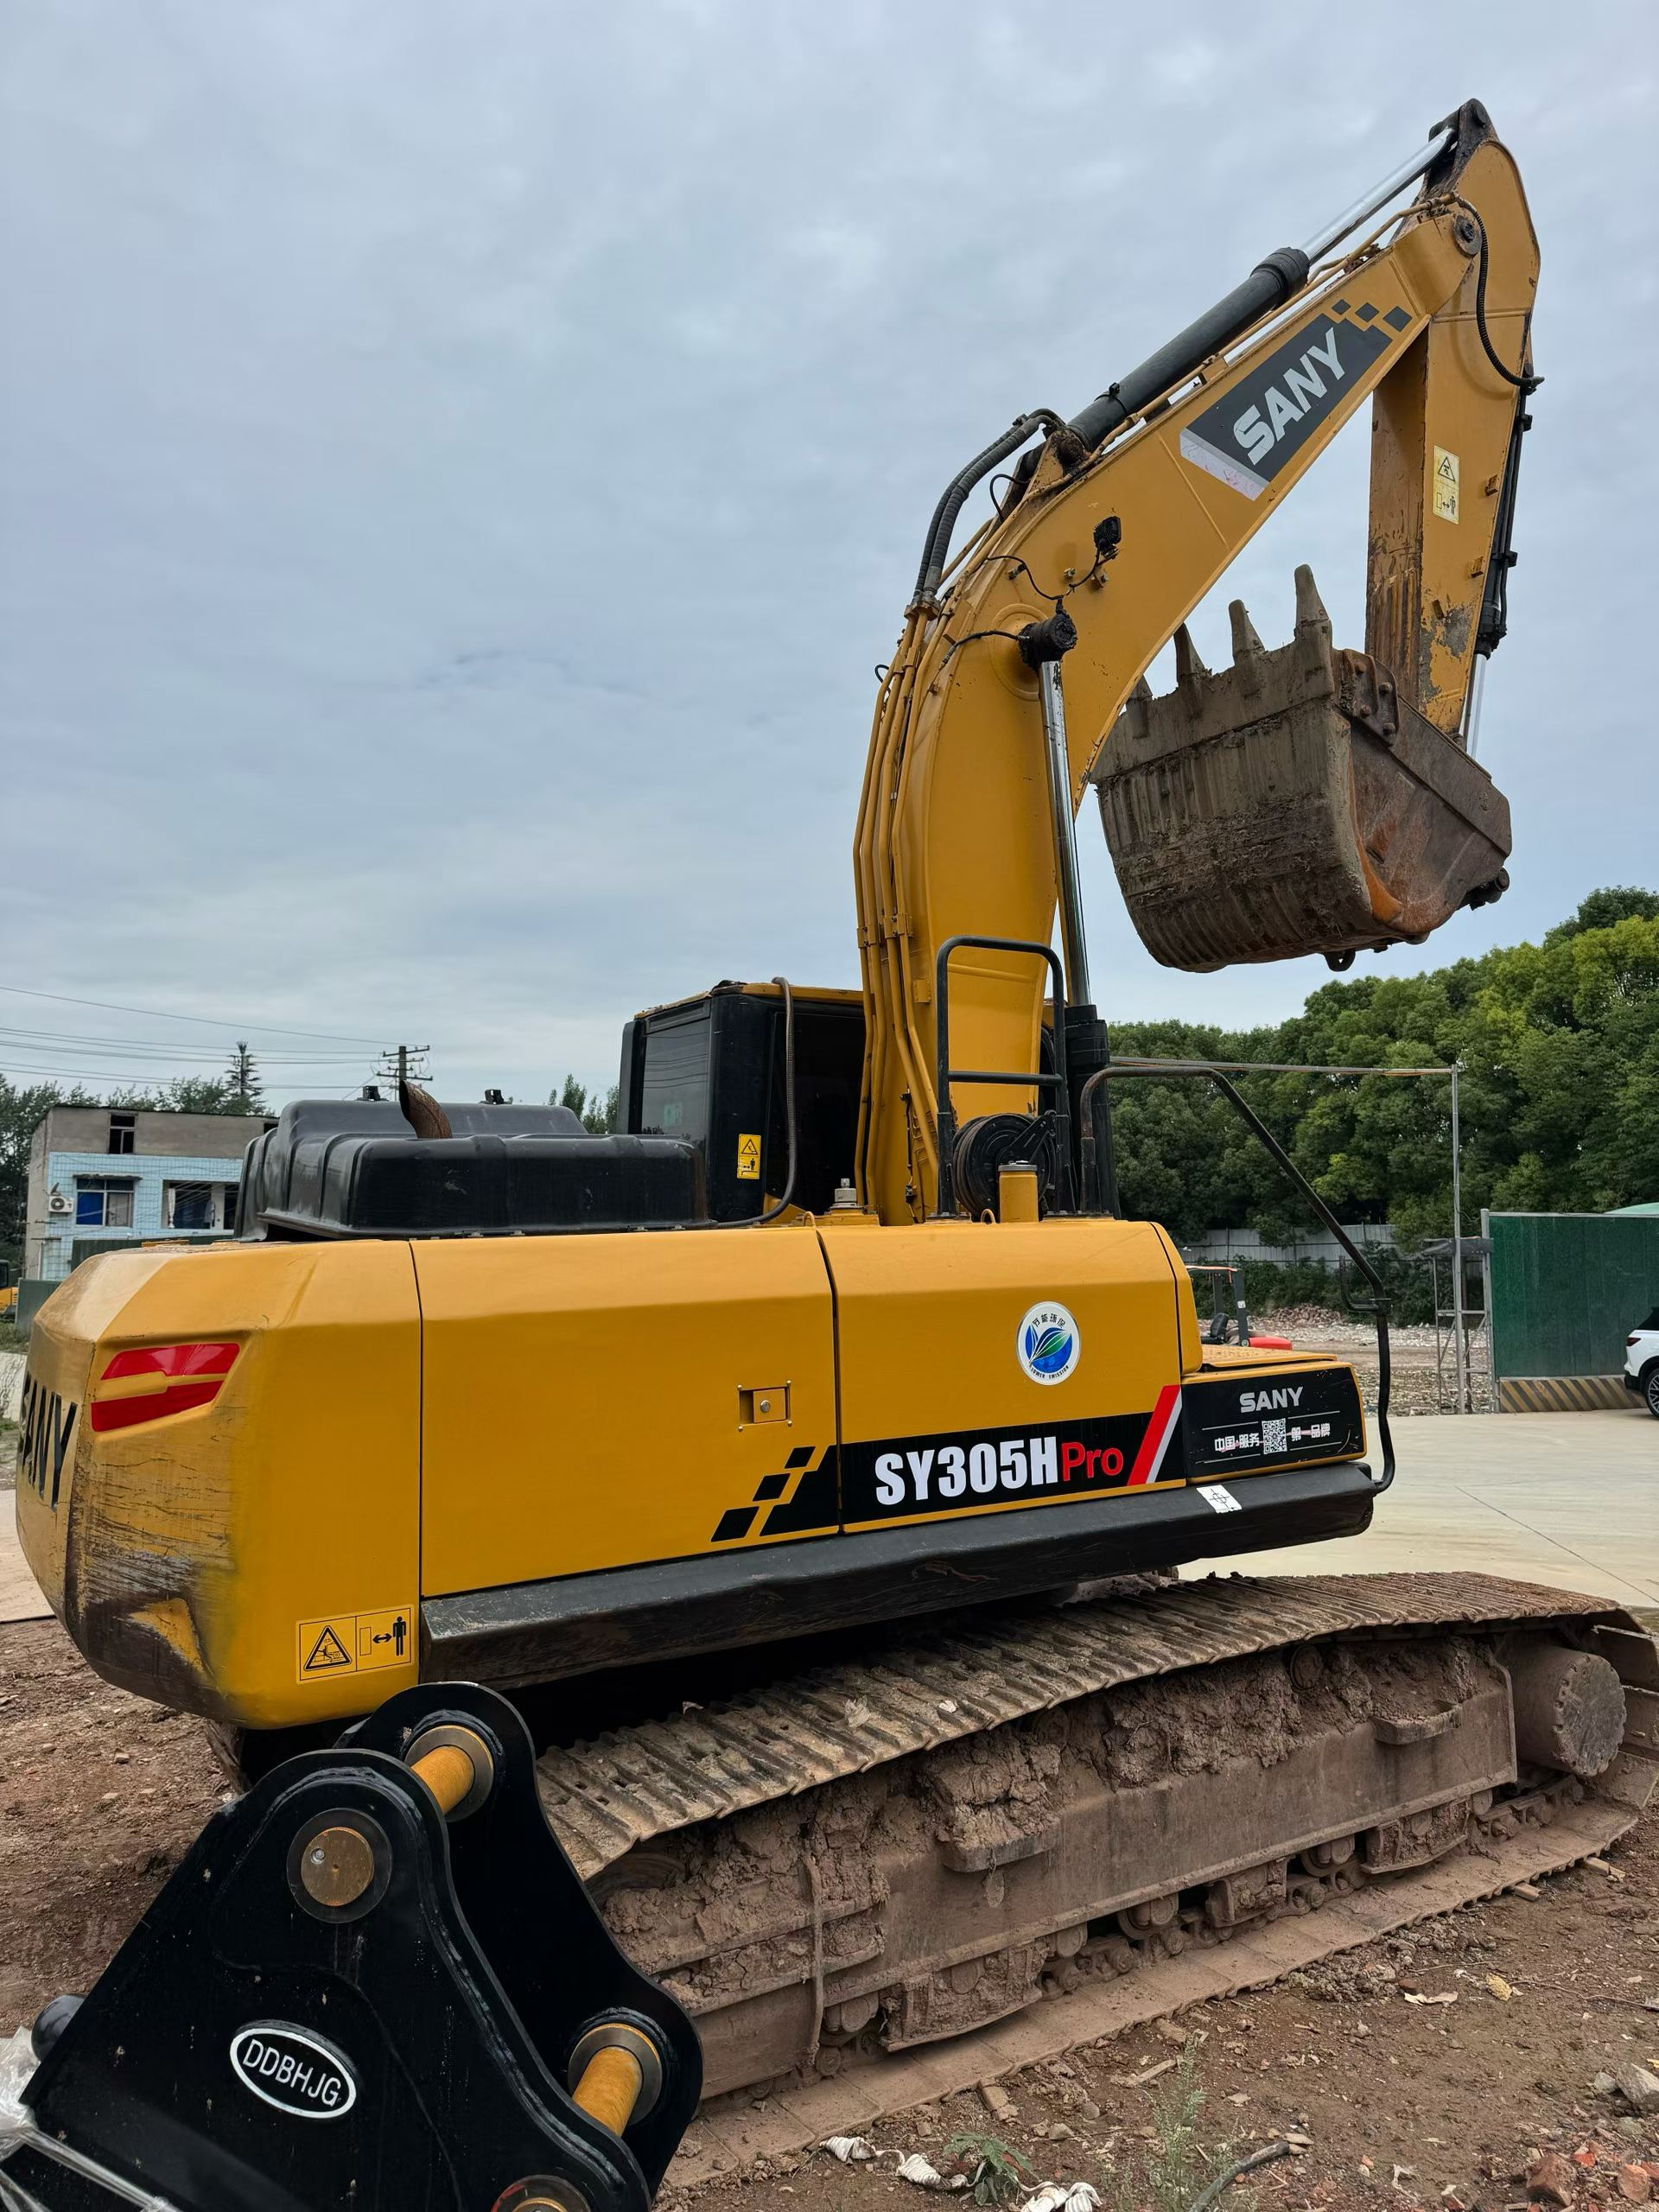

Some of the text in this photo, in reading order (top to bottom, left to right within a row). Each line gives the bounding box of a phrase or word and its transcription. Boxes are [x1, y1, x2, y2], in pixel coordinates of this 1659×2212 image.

[1233, 327, 1345, 467] SANY
[1032, 1313, 1066, 1329] 节能环保
[1030, 1364, 1070, 1380] LOWER EMISSION
[1239, 1386, 1304, 1414] SANY
[242, 2038, 342, 2108] DDBHJG
